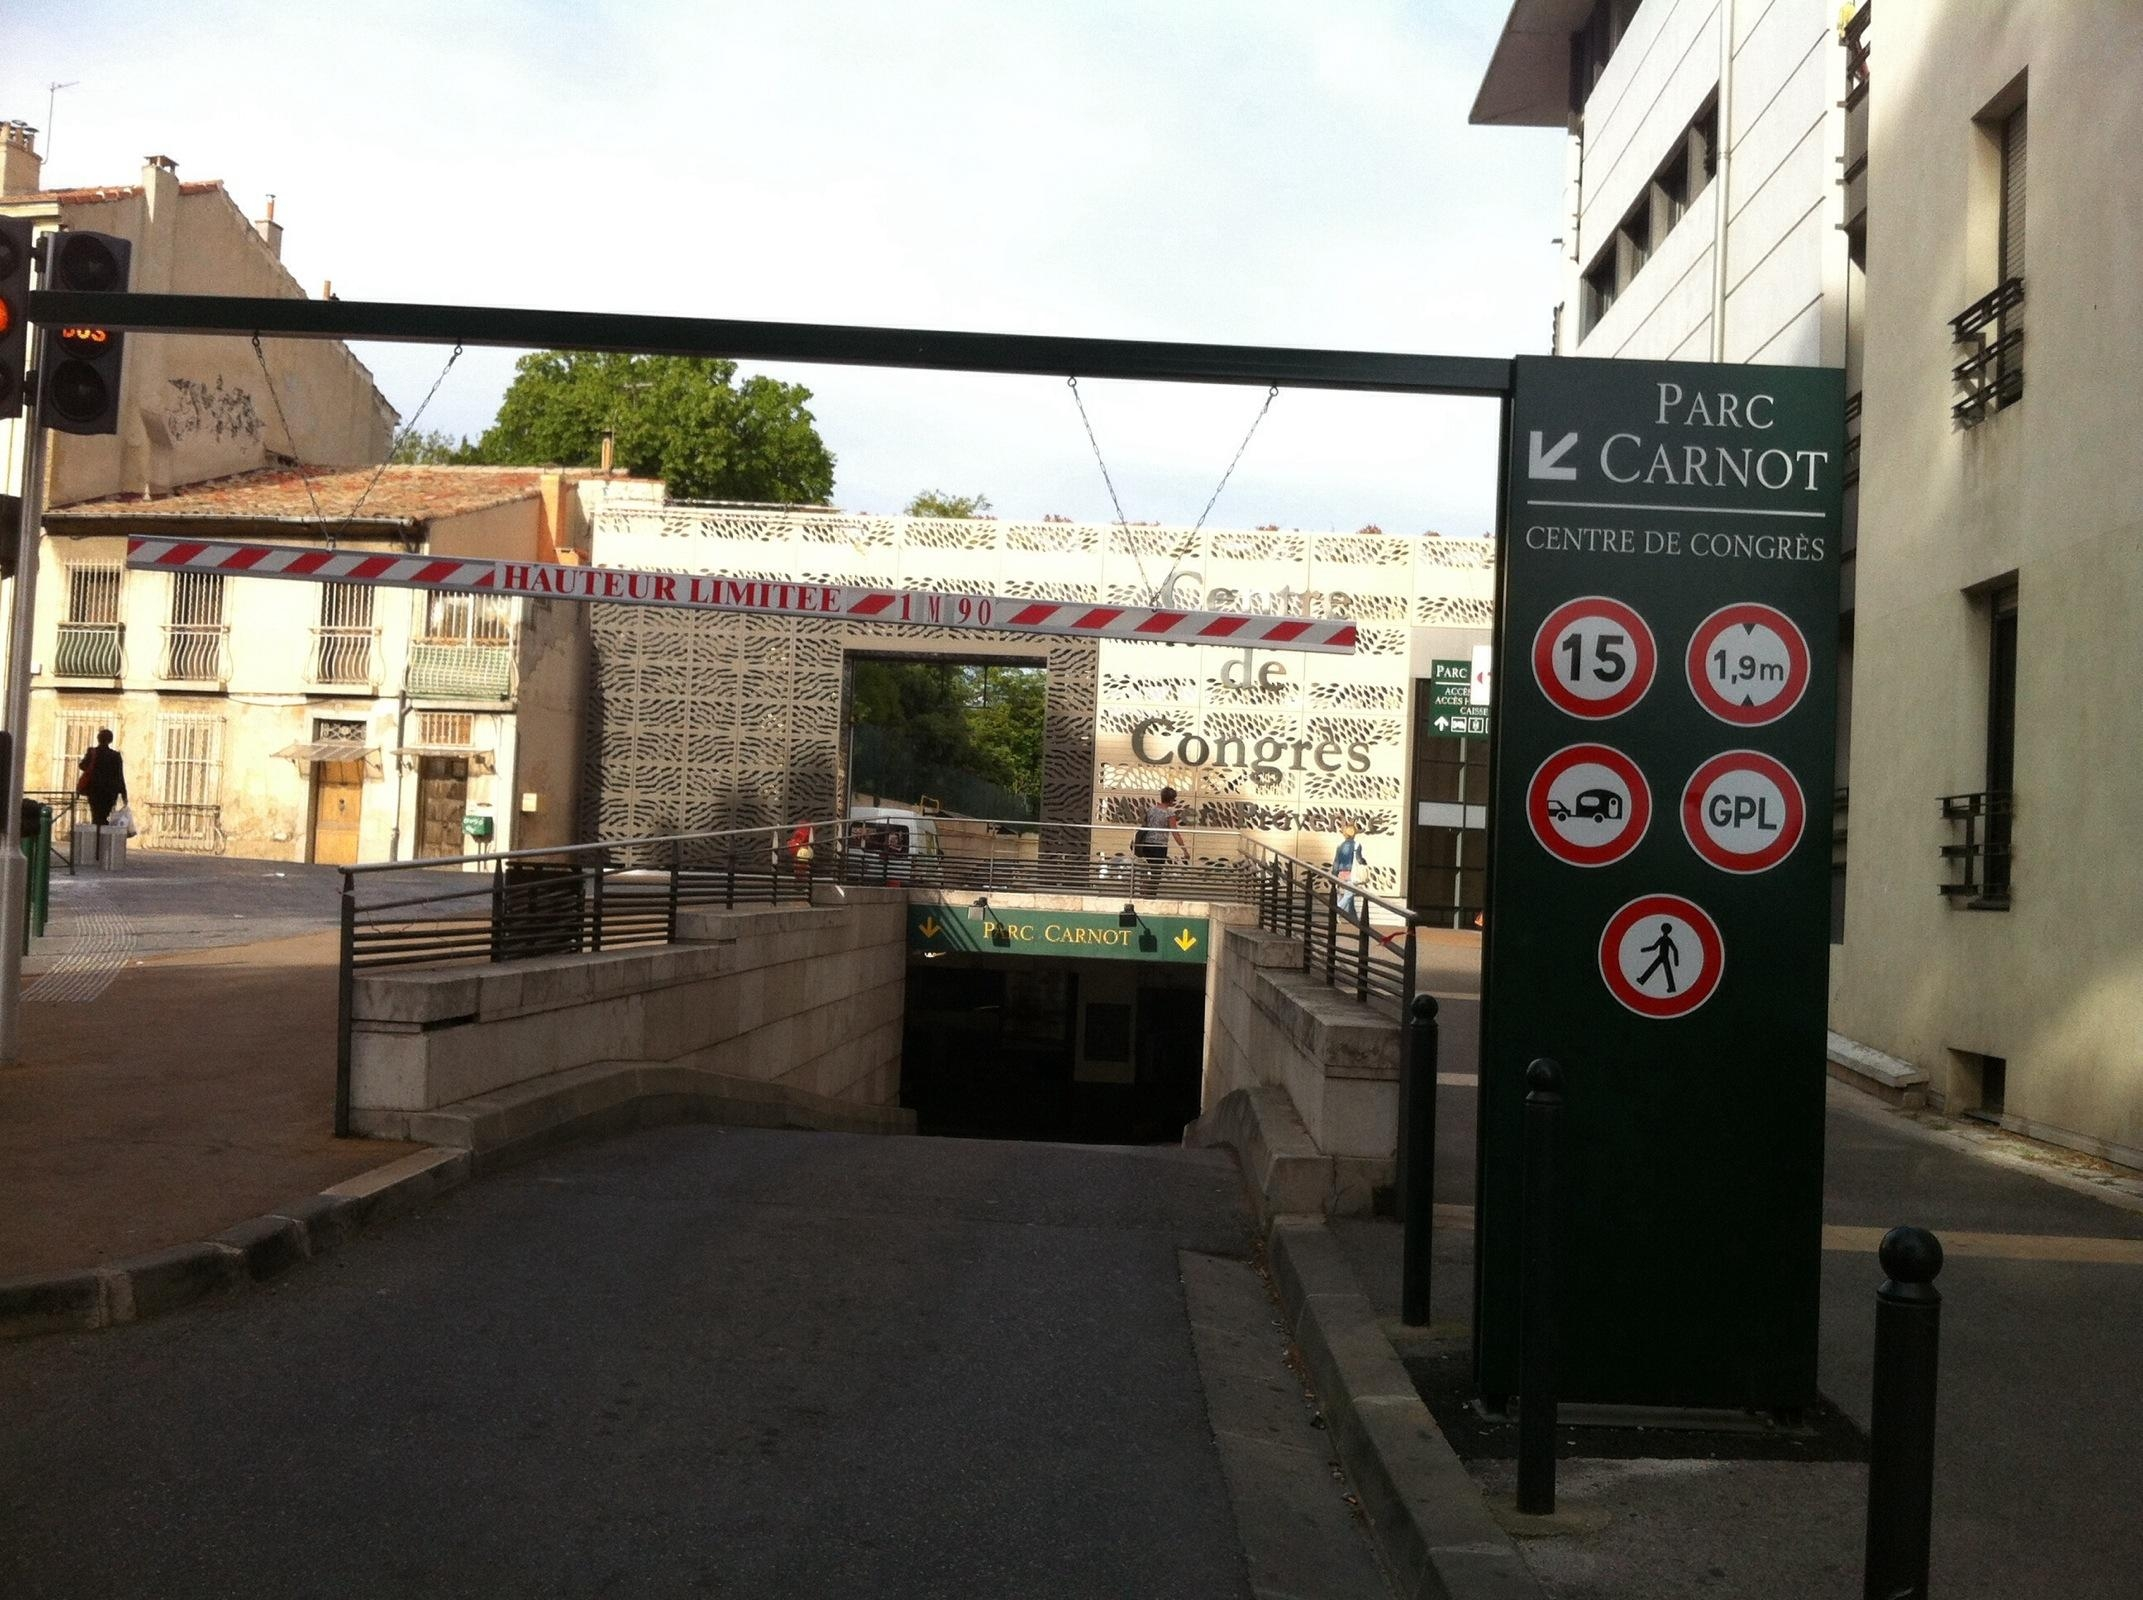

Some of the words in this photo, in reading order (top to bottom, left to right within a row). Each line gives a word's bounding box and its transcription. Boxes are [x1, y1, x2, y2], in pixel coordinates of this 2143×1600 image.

[1655, 382, 1775, 430] PARC
[1600, 433, 1829, 491] CARNOT
[1525, 526, 1635, 554] CENTRE
[1644, 531, 1682, 556] DE
[1690, 533, 1826, 562] CONGRÈS
[503, 565, 678, 601] HAUTEUR
[688, 578, 843, 614] LIMITEE
[957, 597, 992, 626] 90
[1160, 570, 1352, 620] Centre
[1220, 648, 1288, 692] de
[1435, 664, 1468, 679] PARC
[1562, 633, 1627, 683] 15
[1713, 649, 1784, 686] 1,9m
[1131, 716, 1372, 786] Congrès
[1708, 794, 1778, 831] GPL
[983, 921, 1035, 942] PARC
[1044, 924, 1132, 946] CARNOT
